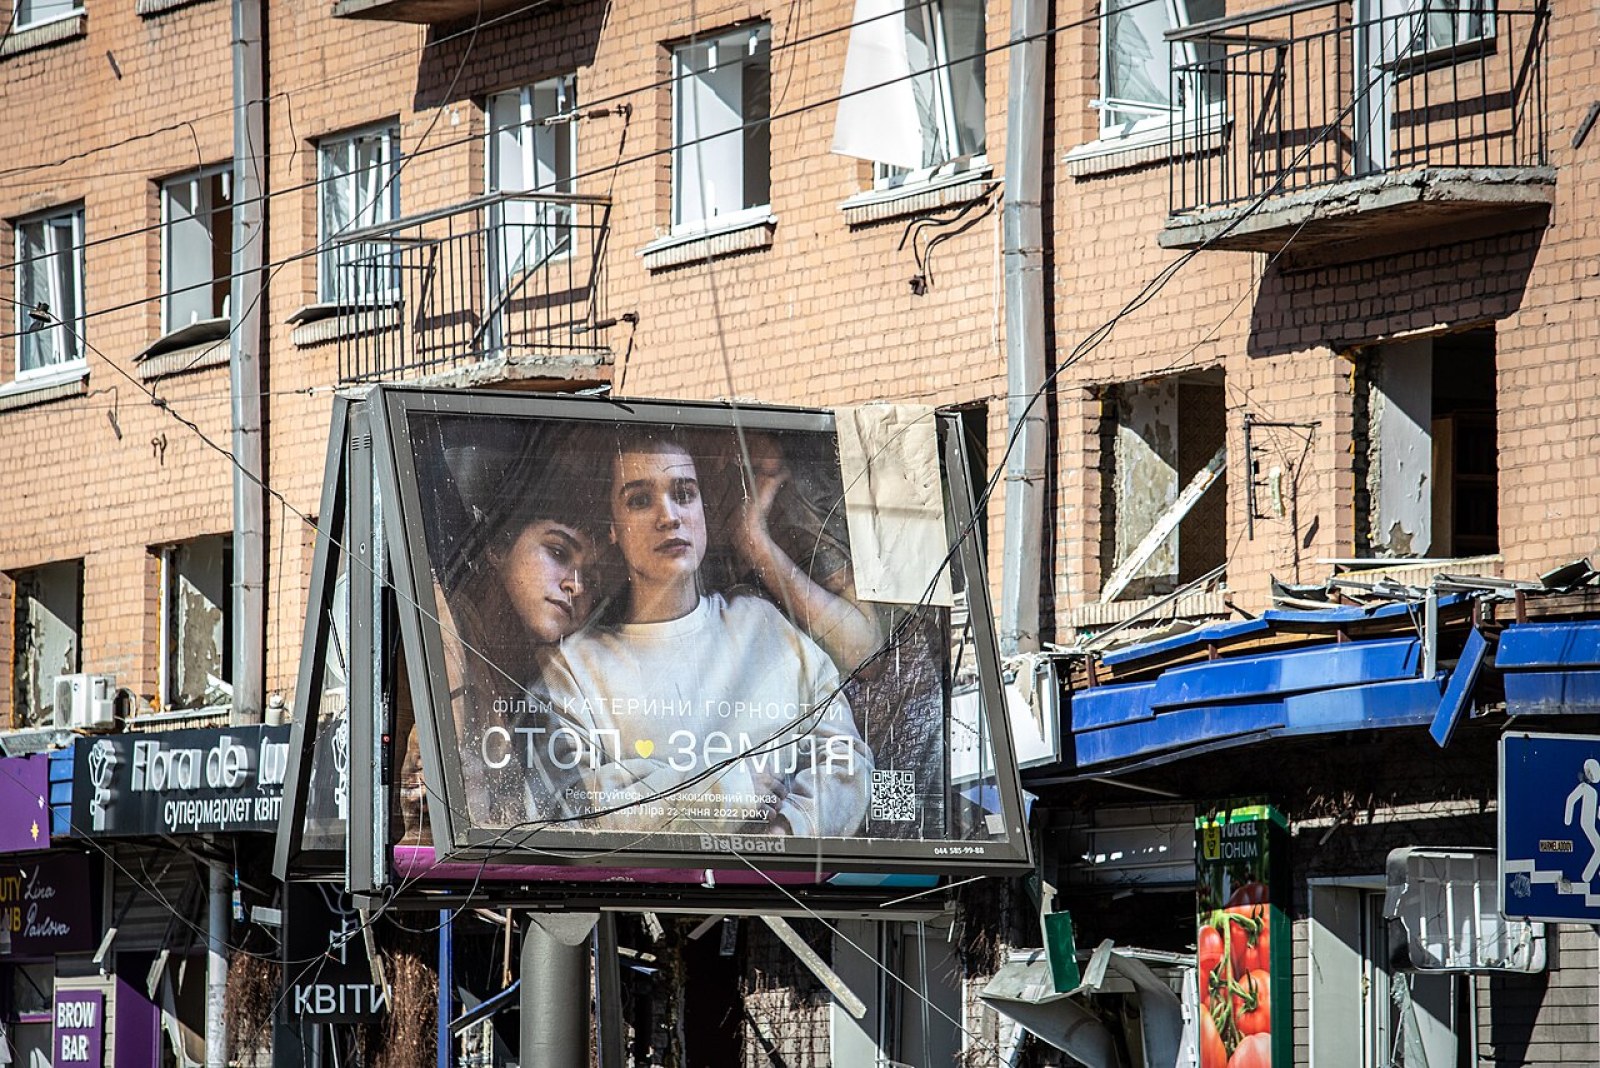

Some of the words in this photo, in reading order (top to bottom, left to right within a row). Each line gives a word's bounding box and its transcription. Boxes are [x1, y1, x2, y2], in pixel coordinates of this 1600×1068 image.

[492, 696, 551, 717] фільм
[563, 697, 692, 717] КАТЕРИНИ
[206, 735, 248, 789] de
[745, 794, 777, 804] показ
[164, 798, 252, 832] супермаркет
[254, 796, 283, 822] квіт
[713, 809, 738, 818] 2022
[741, 809, 769, 820] року
[700, 836, 786, 853] BigBoard
[1220, 841, 1258, 859] TOHUM
[294, 984, 392, 1014] КВІТИ
[57, 1002, 96, 1029] BROW
[62, 1035, 89, 1062] BAR
